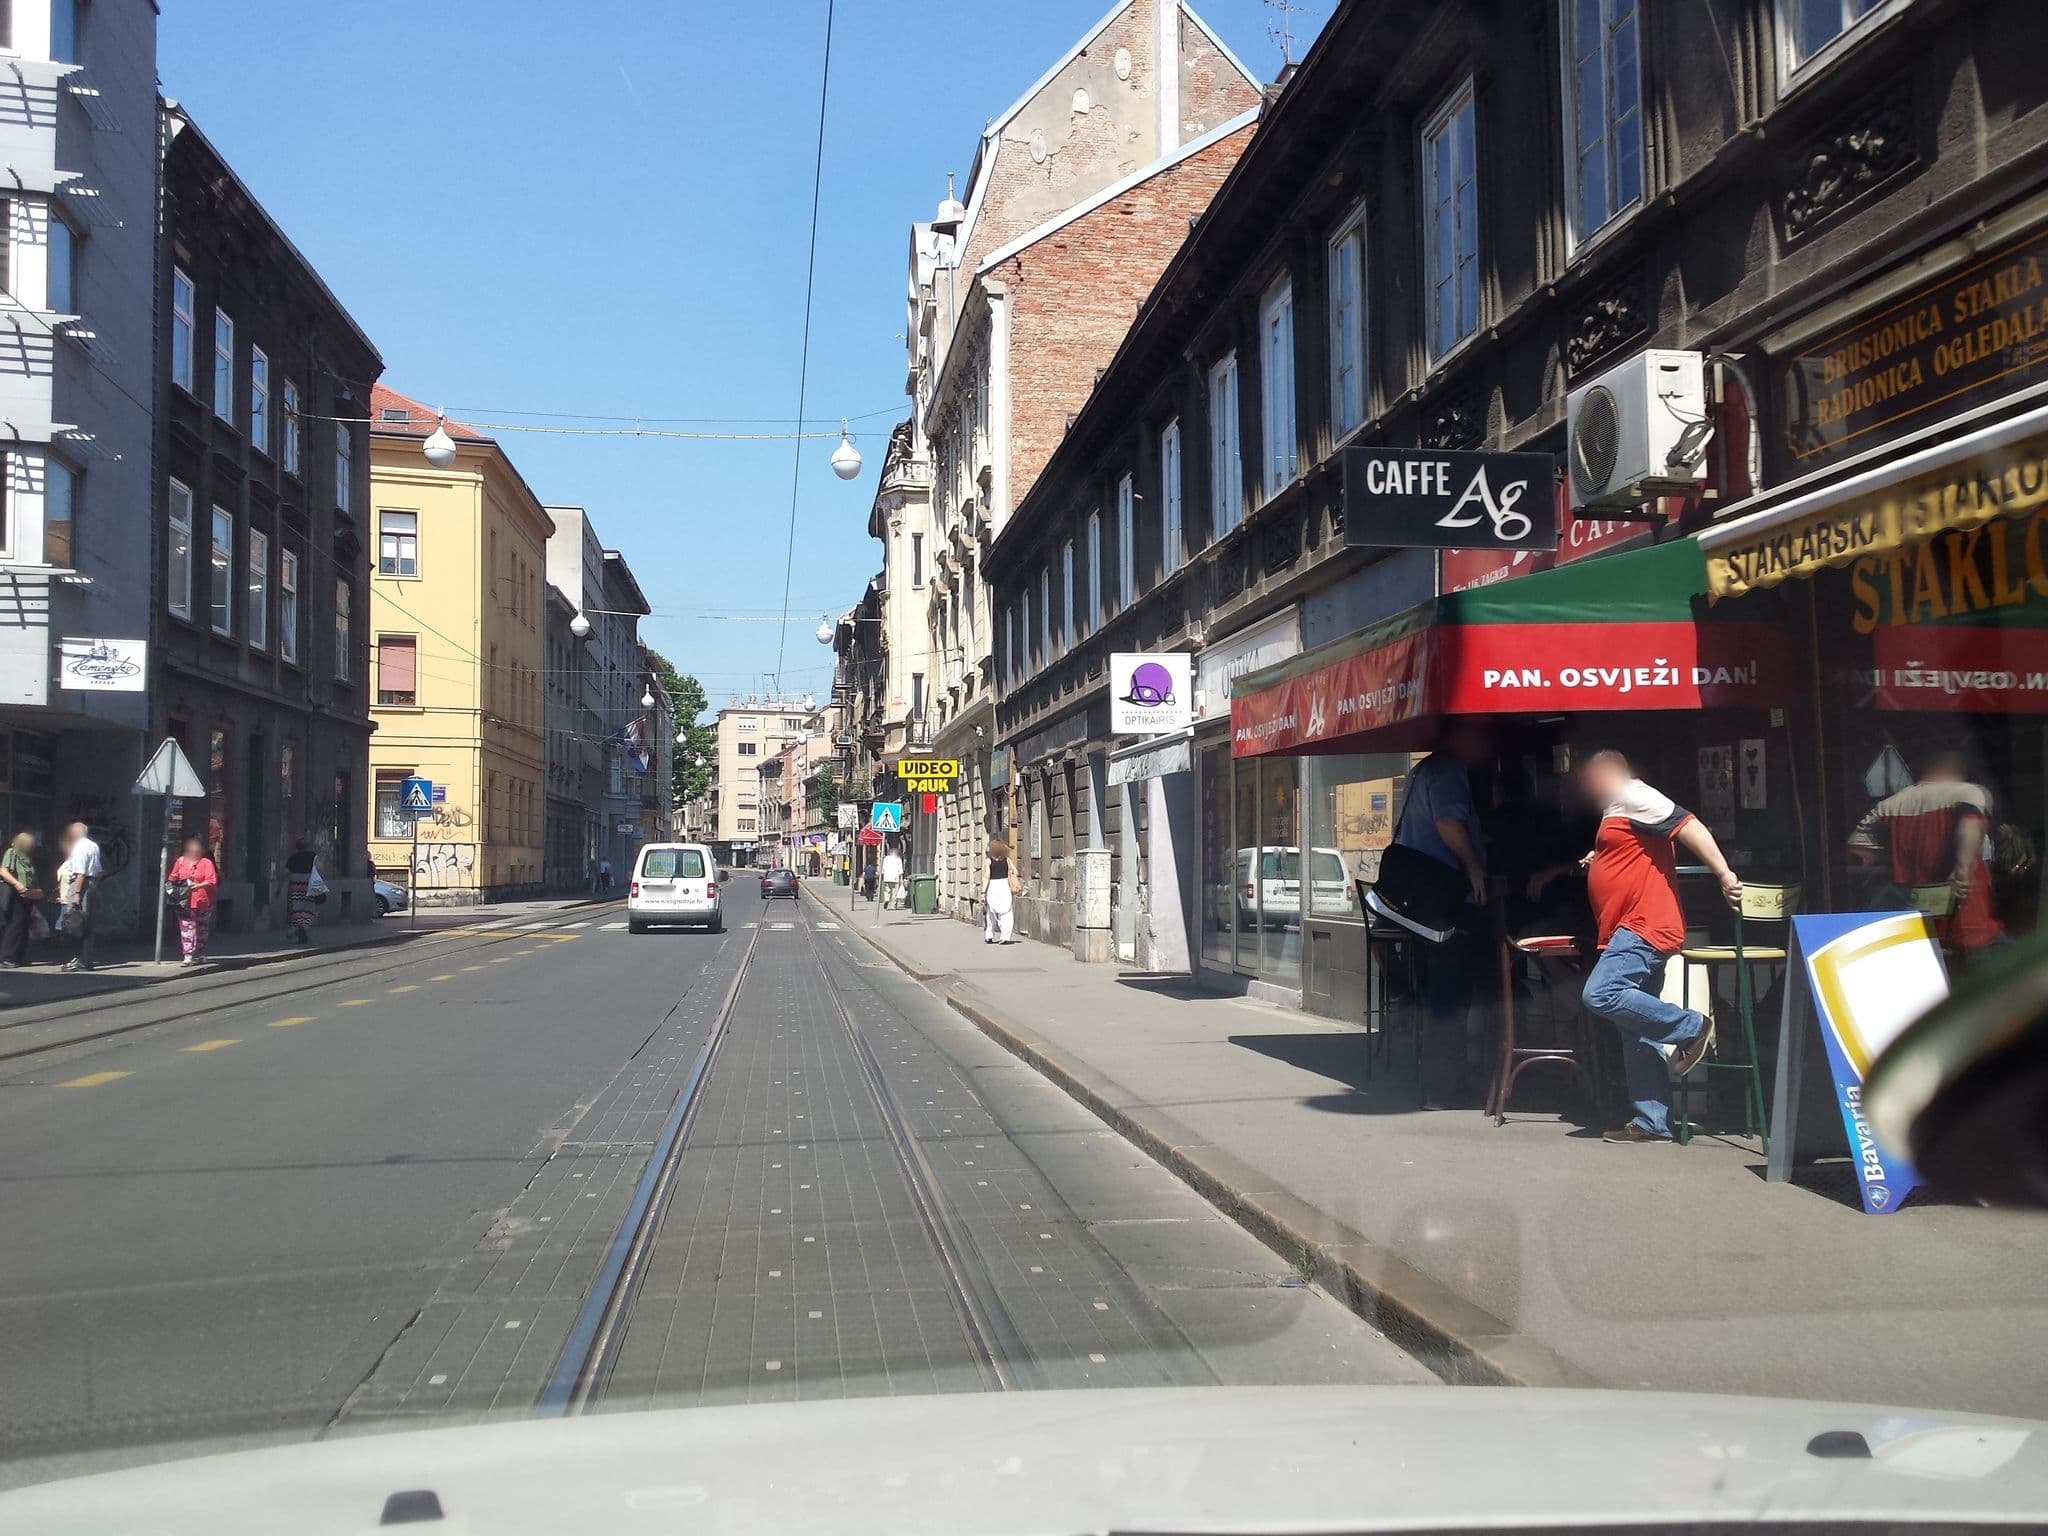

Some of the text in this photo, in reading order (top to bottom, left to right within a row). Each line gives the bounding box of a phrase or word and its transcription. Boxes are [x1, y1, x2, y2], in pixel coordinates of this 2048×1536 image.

[1823, 256, 2043, 385] BRUSIONICA STAKLA
[1817, 357, 1924, 427] RADIONICA
[1366, 458, 1533, 541] CAFFE Ag
[1727, 516, 1880, 584] STAKLARSKA
[1483, 657, 1757, 693] PAN. OSVJEŽI DAN!
[904, 762, 953, 774] VIDEO
[907, 778, 950, 792] PAUK
[1845, 1086, 1886, 1182] Bavaria
